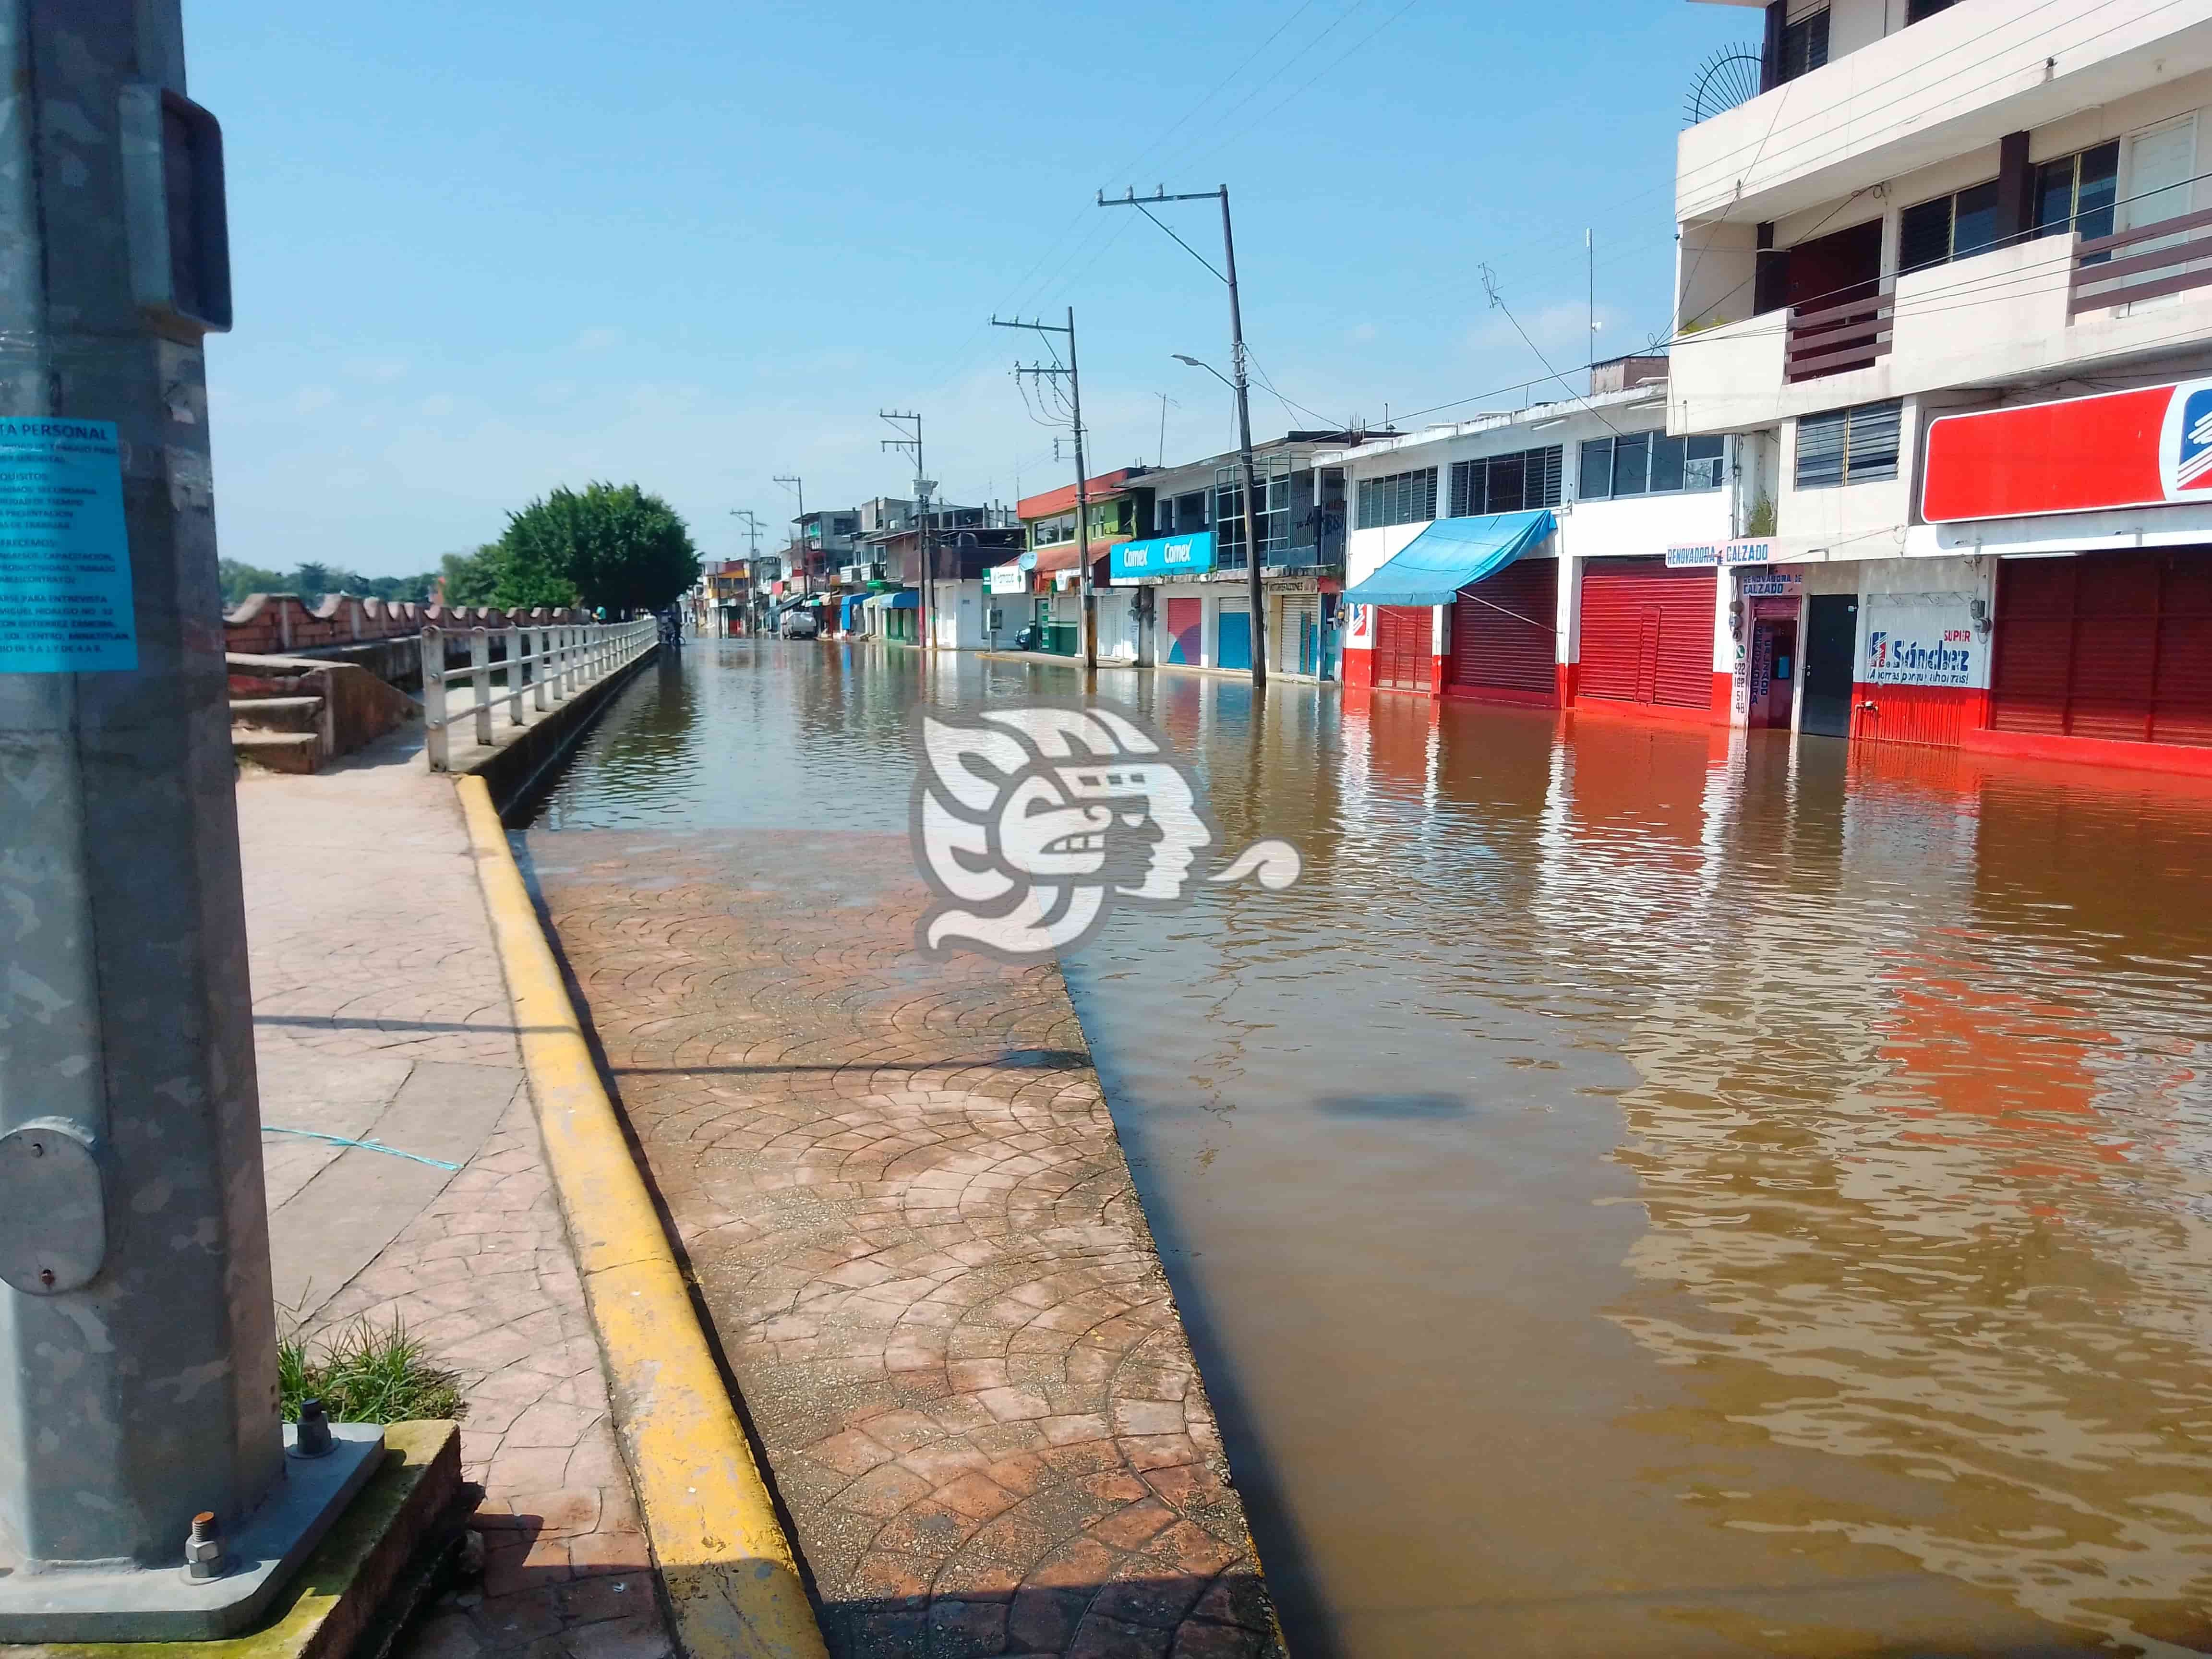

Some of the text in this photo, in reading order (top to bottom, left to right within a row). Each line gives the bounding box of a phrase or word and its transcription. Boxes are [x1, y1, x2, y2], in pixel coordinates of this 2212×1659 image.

[23, 424, 108, 440] PERSONAL
[1124, 543, 1149, 567] Comex
[1164, 538, 1193, 564] Comex
[1667, 546, 1715, 565] RENOVADORA
[1727, 544, 1768, 562] CALZADO
[1743, 575, 1791, 584] RENOVADORA
[1743, 583, 1783, 595] CALZADO
[49, 595, 108, 603] ENTREVISTA
[1944, 630, 1971, 642] SUPER
[1892, 639, 1969, 672] Sánchez
[1734, 662, 1745, 675] 922
[1736, 691, 1743, 702] 51
